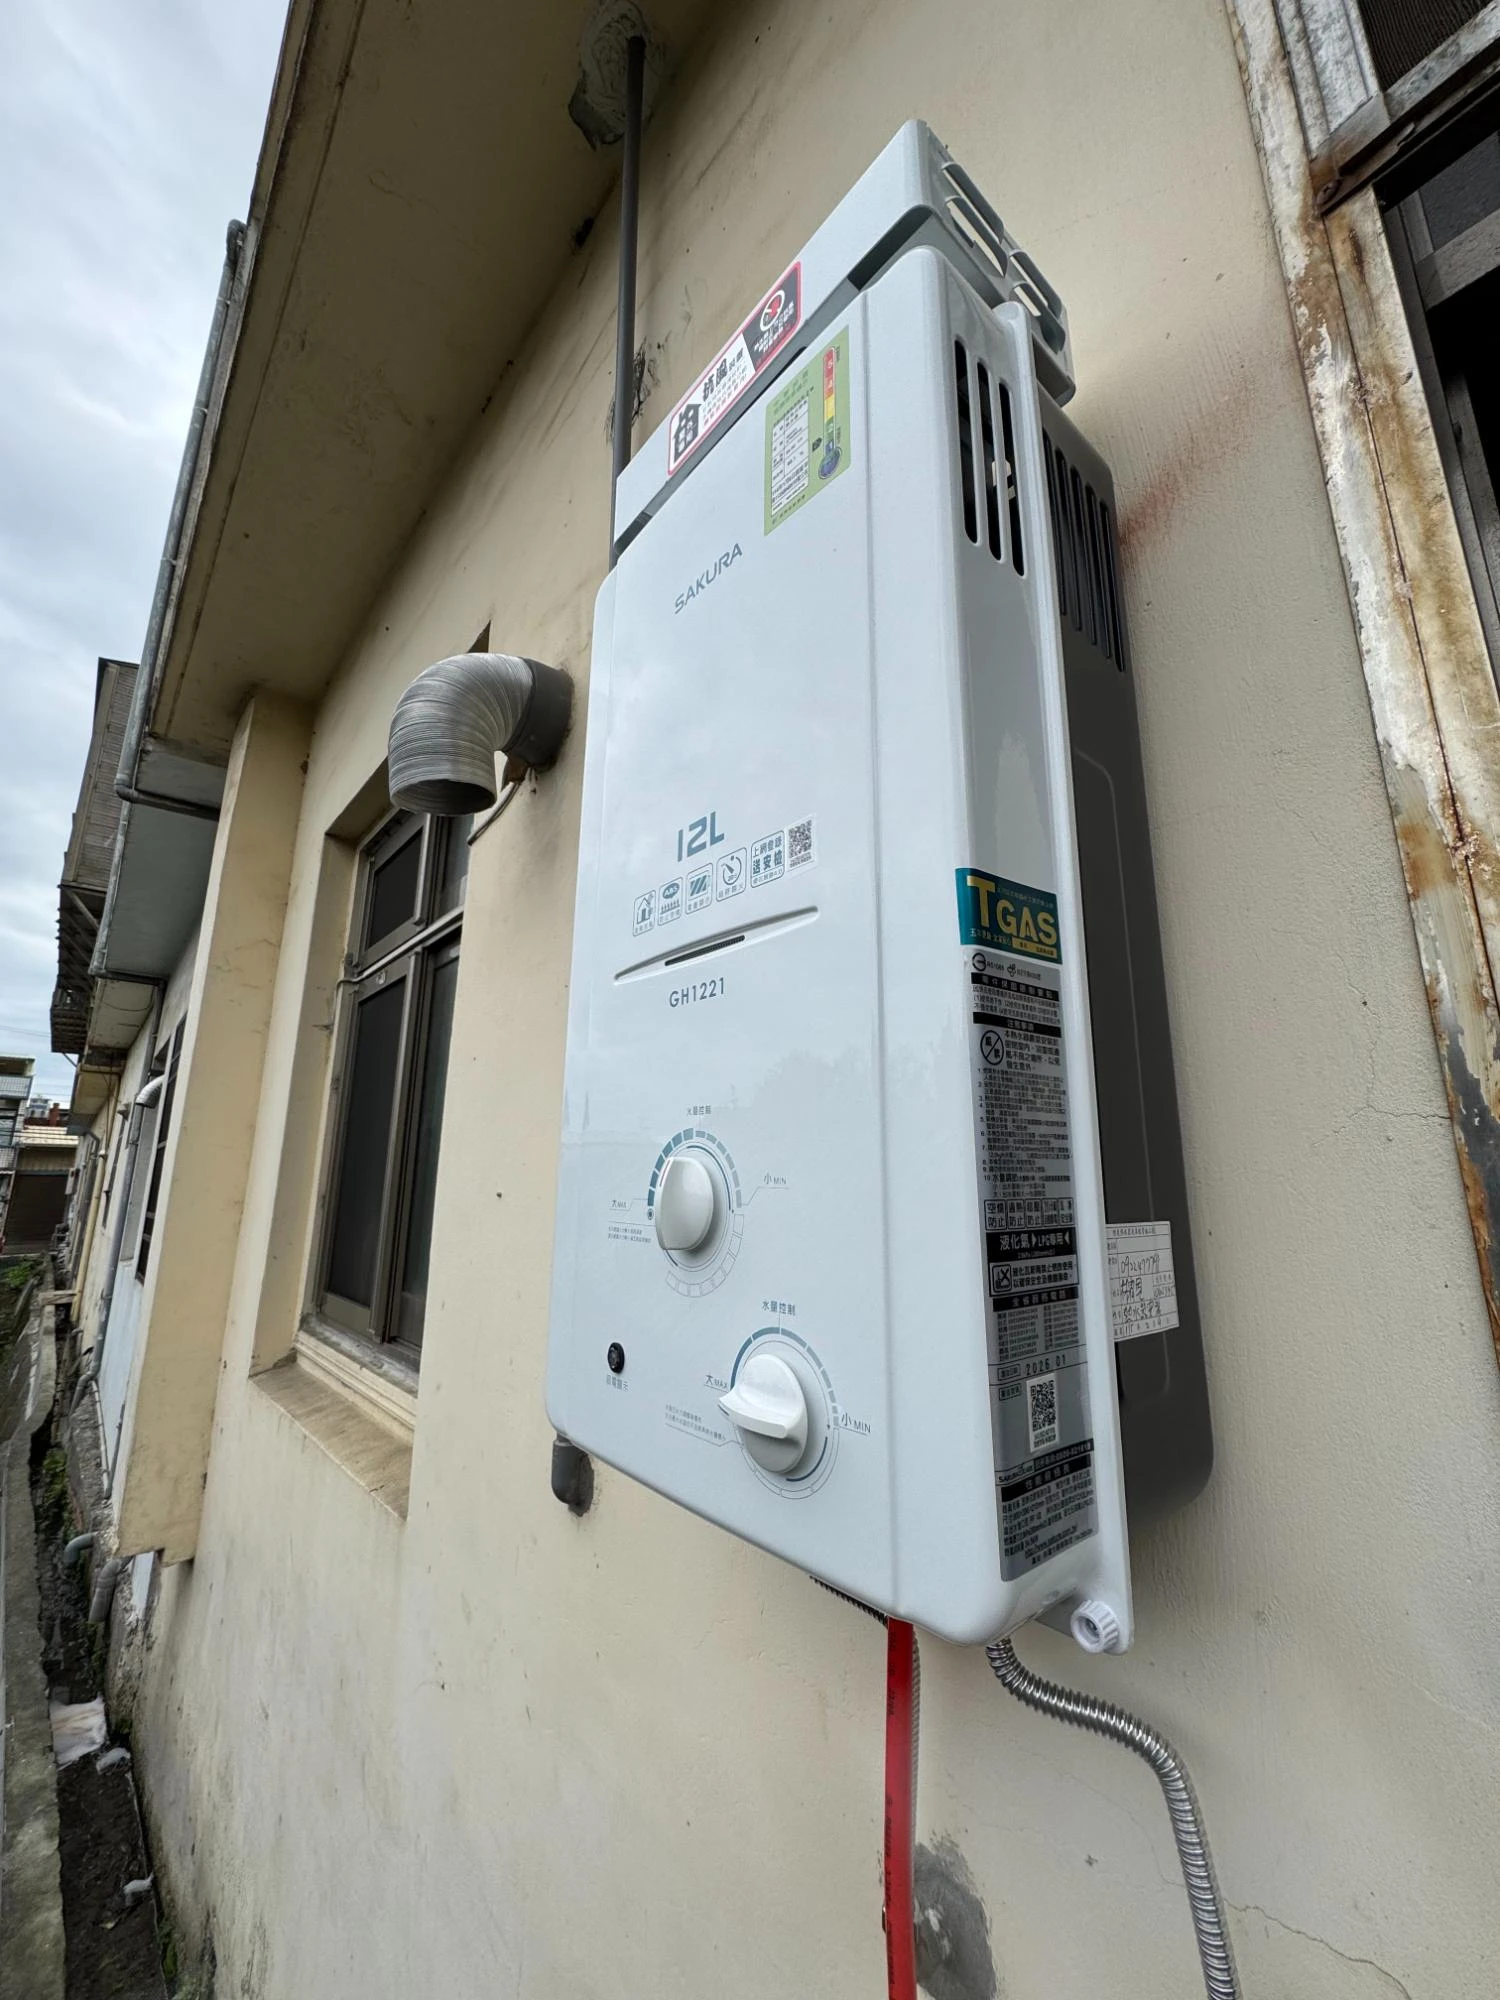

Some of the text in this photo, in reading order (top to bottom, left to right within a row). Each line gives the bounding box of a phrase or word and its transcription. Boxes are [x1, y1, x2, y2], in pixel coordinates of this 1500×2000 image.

[675, 543, 742, 614] SAKURA
[677, 811, 725, 863] 12L
[670, 977, 724, 1007] GH1221
[1000, 1232, 1030, 1251] 液化氣
[762, 1300, 796, 1316] 水量控制
